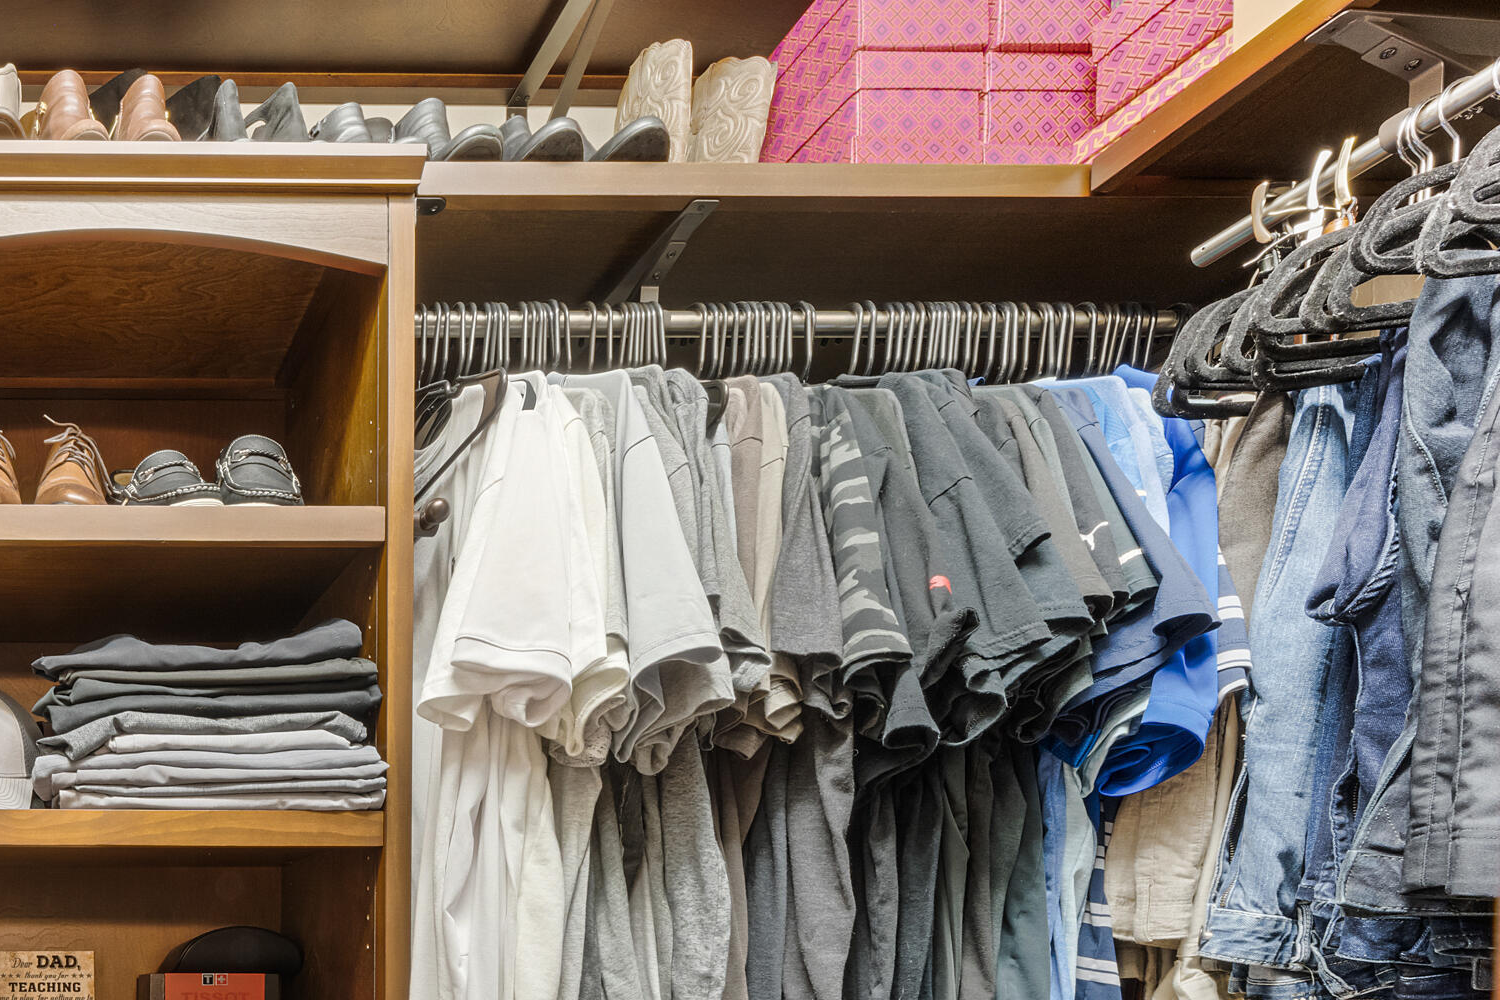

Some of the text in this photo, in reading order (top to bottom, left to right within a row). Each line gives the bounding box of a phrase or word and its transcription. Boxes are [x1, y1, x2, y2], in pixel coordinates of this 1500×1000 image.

[11, 954, 81, 971] Dear DAD,
[24, 971, 69, 981] thank you for
[8, 982, 81, 993] TEACHING
[86, 993, 94, 1000] to
